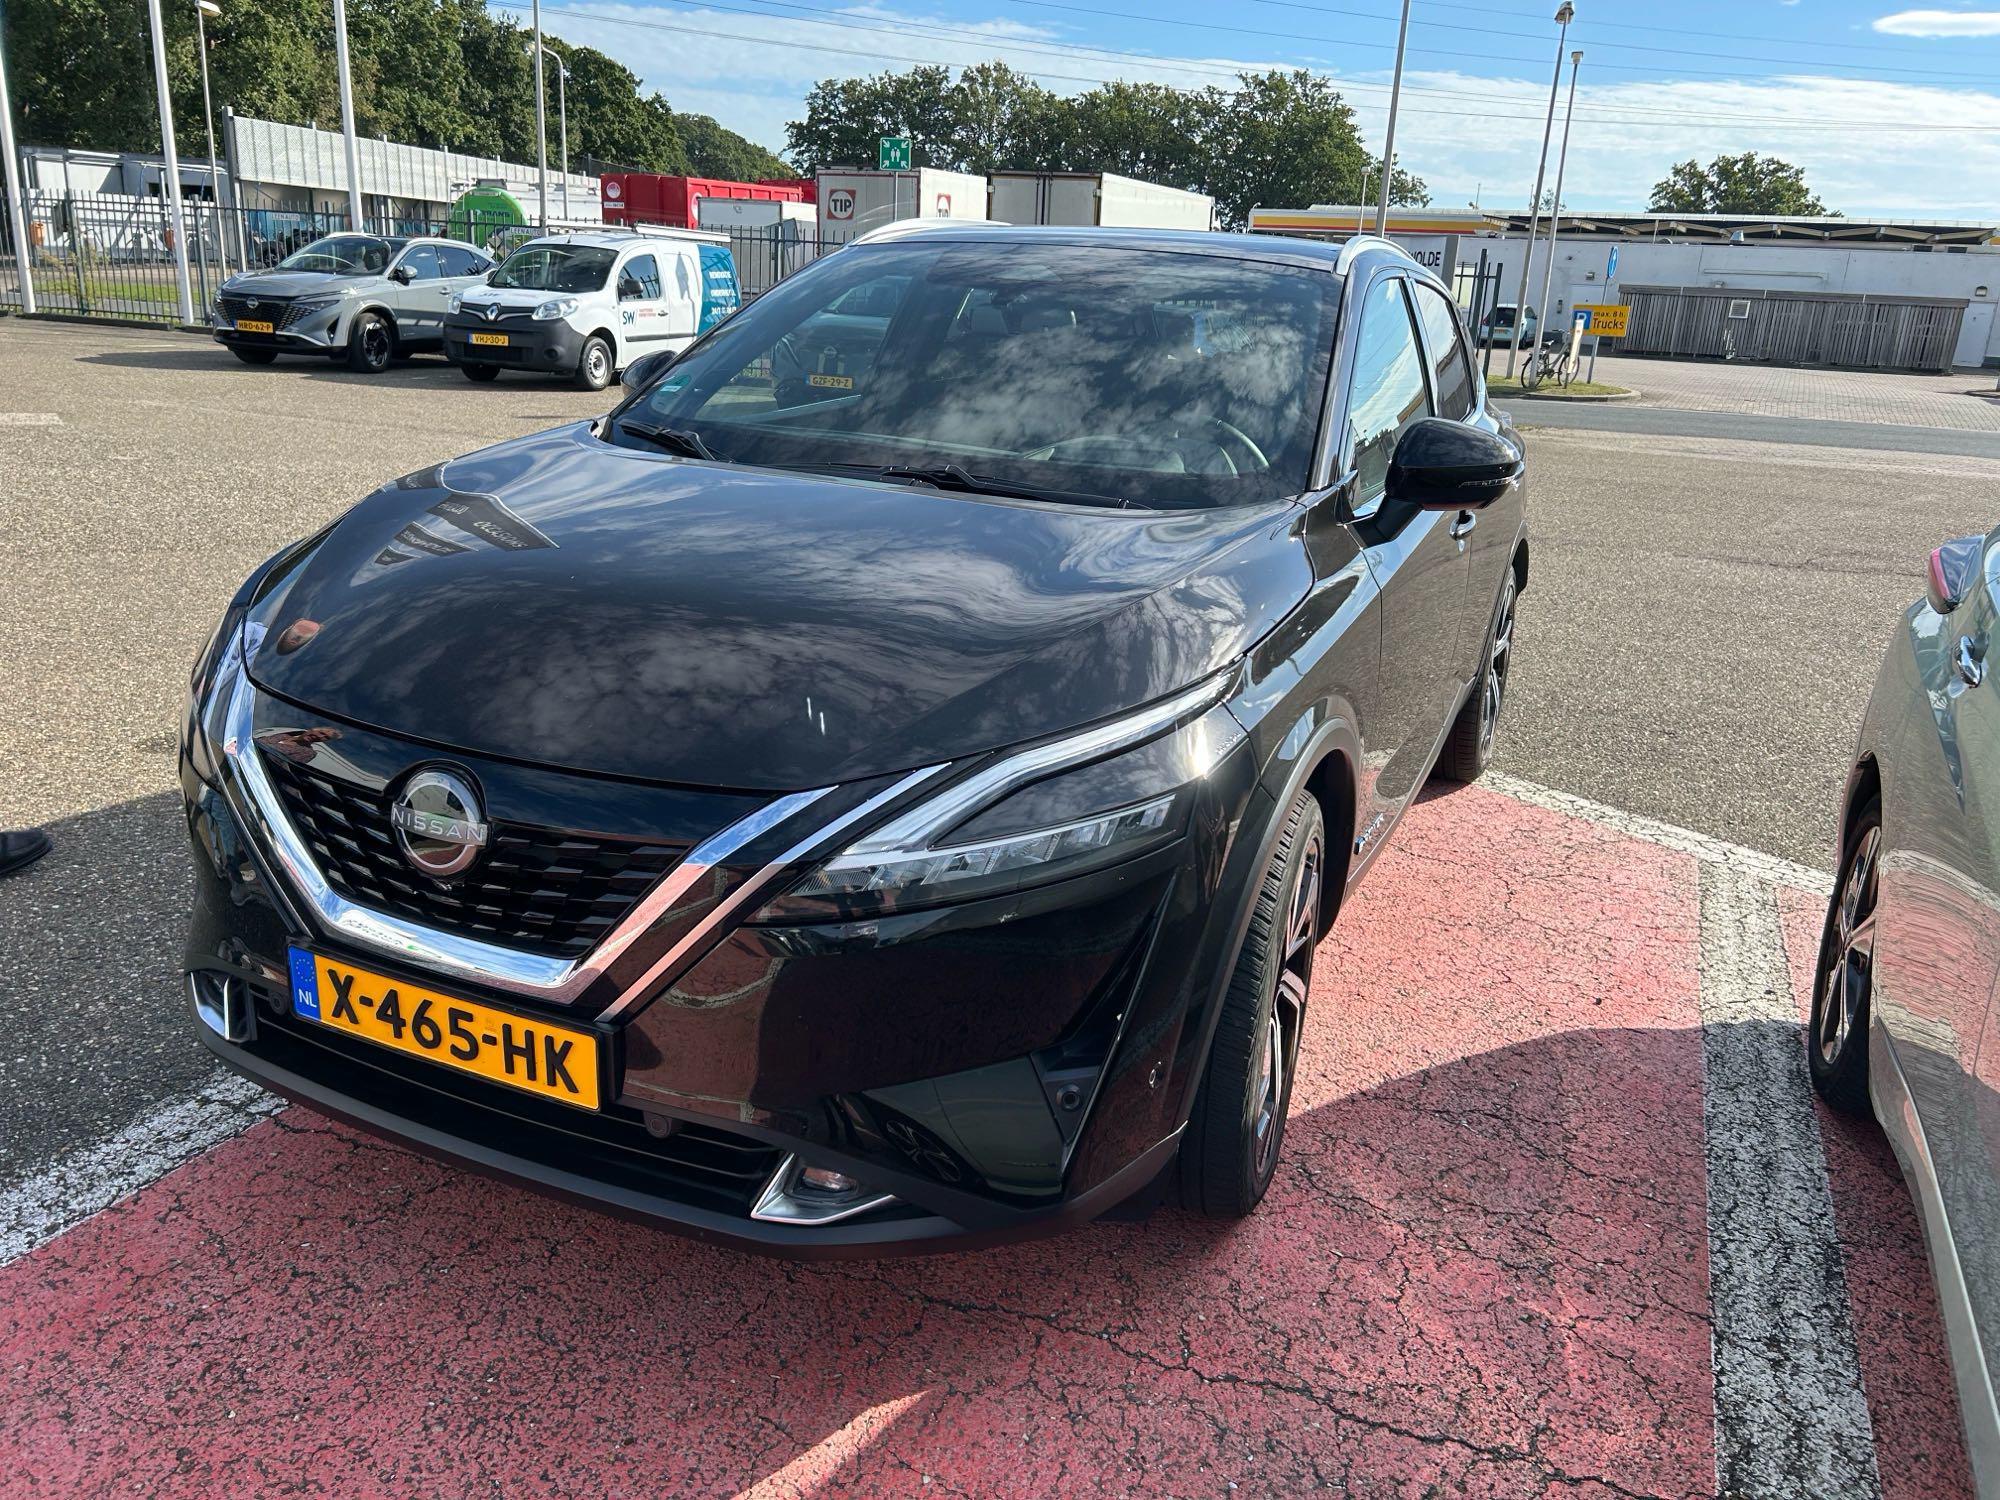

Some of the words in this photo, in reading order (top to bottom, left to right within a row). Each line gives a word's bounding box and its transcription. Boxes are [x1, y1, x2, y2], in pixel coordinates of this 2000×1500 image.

[832, 199, 852, 213] TIP
[622, 311, 635, 325] SW
[1593, 318, 1625, 330] Trucks
[812, 376, 850, 388] GZF-29-Z
[392, 807, 484, 842] NISSAN
[298, 988, 317, 1009] NL
[327, 968, 580, 1094] X-465-HK
